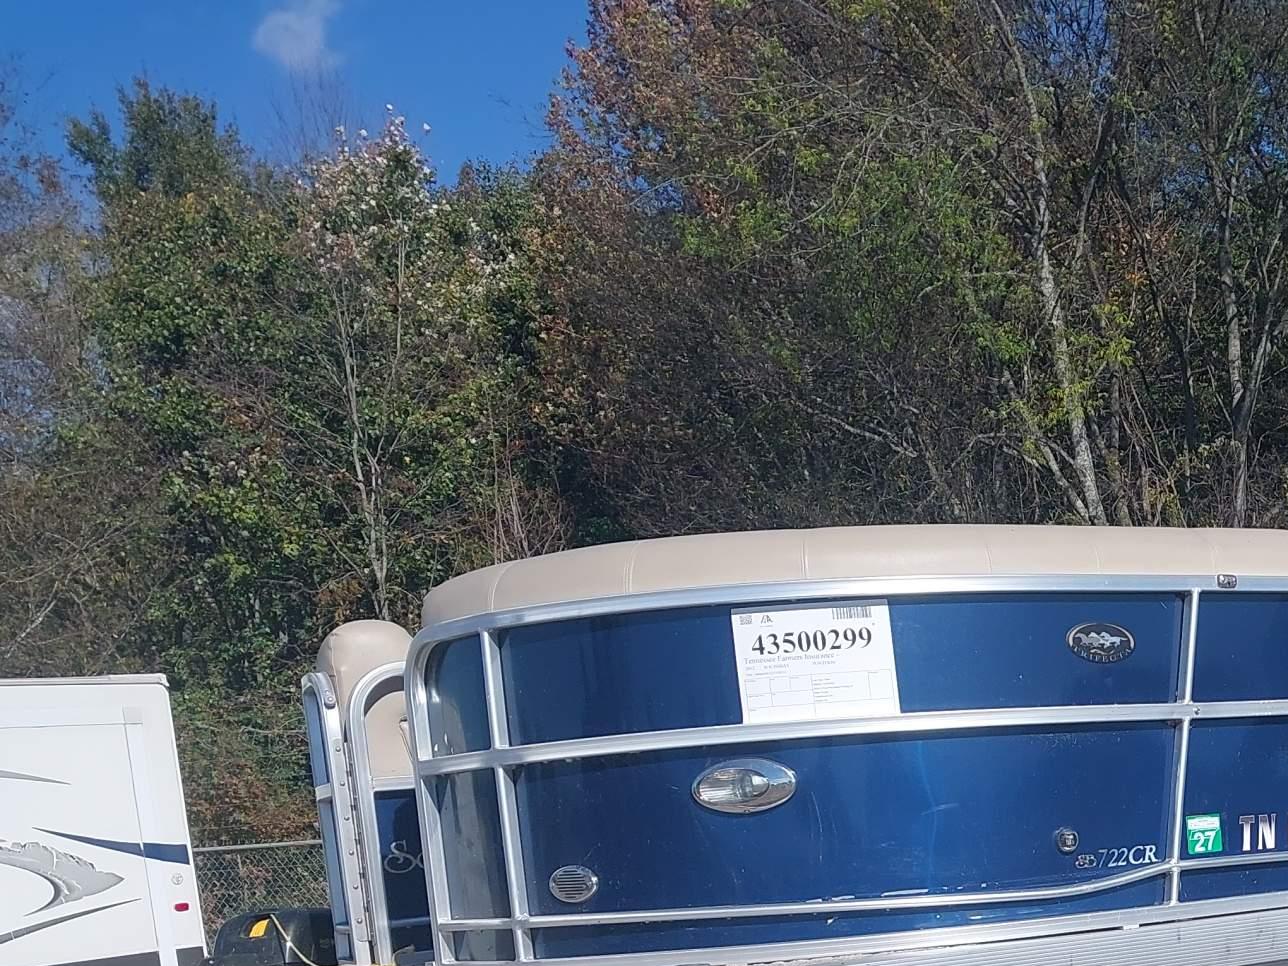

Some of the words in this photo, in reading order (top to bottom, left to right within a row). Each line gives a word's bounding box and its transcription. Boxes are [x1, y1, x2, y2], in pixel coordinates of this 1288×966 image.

[751, 627, 872, 656] 43500299
[1193, 831, 1217, 853] 27
[1238, 813, 1278, 851] TN
